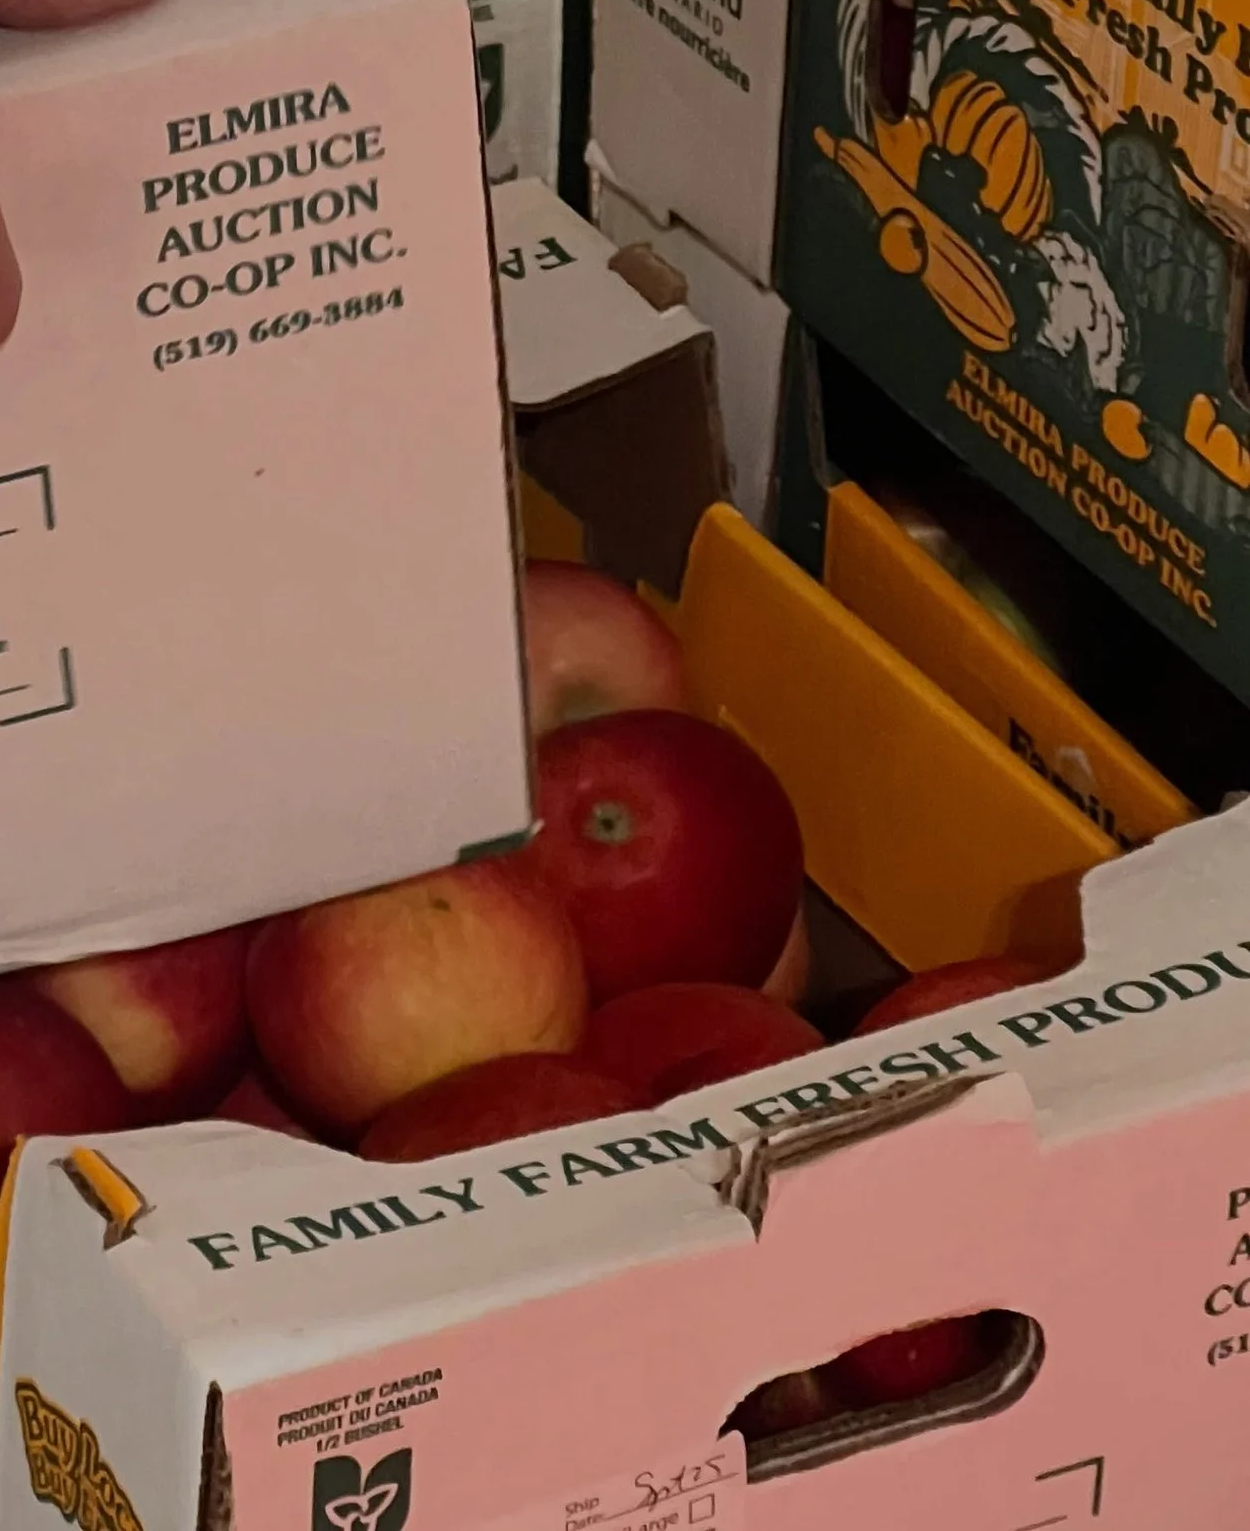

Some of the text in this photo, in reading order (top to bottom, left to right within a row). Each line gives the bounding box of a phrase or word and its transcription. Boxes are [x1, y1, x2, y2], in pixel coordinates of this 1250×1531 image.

[658, 0, 752, 94] nourricière
[165, 81, 353, 157] ELMIRA
[140, 125, 388, 215] PRODUCE
[155, 176, 382, 265] AUCTION
[135, 225, 410, 320] CO-OP INC.
[151, 285, 407, 372] (519) 669-3884
[945, 378, 1219, 629] AUCTION CO-OP INC.
[962, 350, 1207, 577] ELMIRA PRODUCE
[187, 1176, 485, 1270] FAMILY
[498, 1116, 743, 1198] FARM
[997, 942, 1250, 1048] PROD
[277, 1386, 439, 1448] PRODUIT DU CANADA
[278, 1367, 443, 1430] PRODUCT OF CANADA
[316, 1416, 405, 1453] 1/2 BUSHEL
[565, 1496, 600, 1518] Ship
